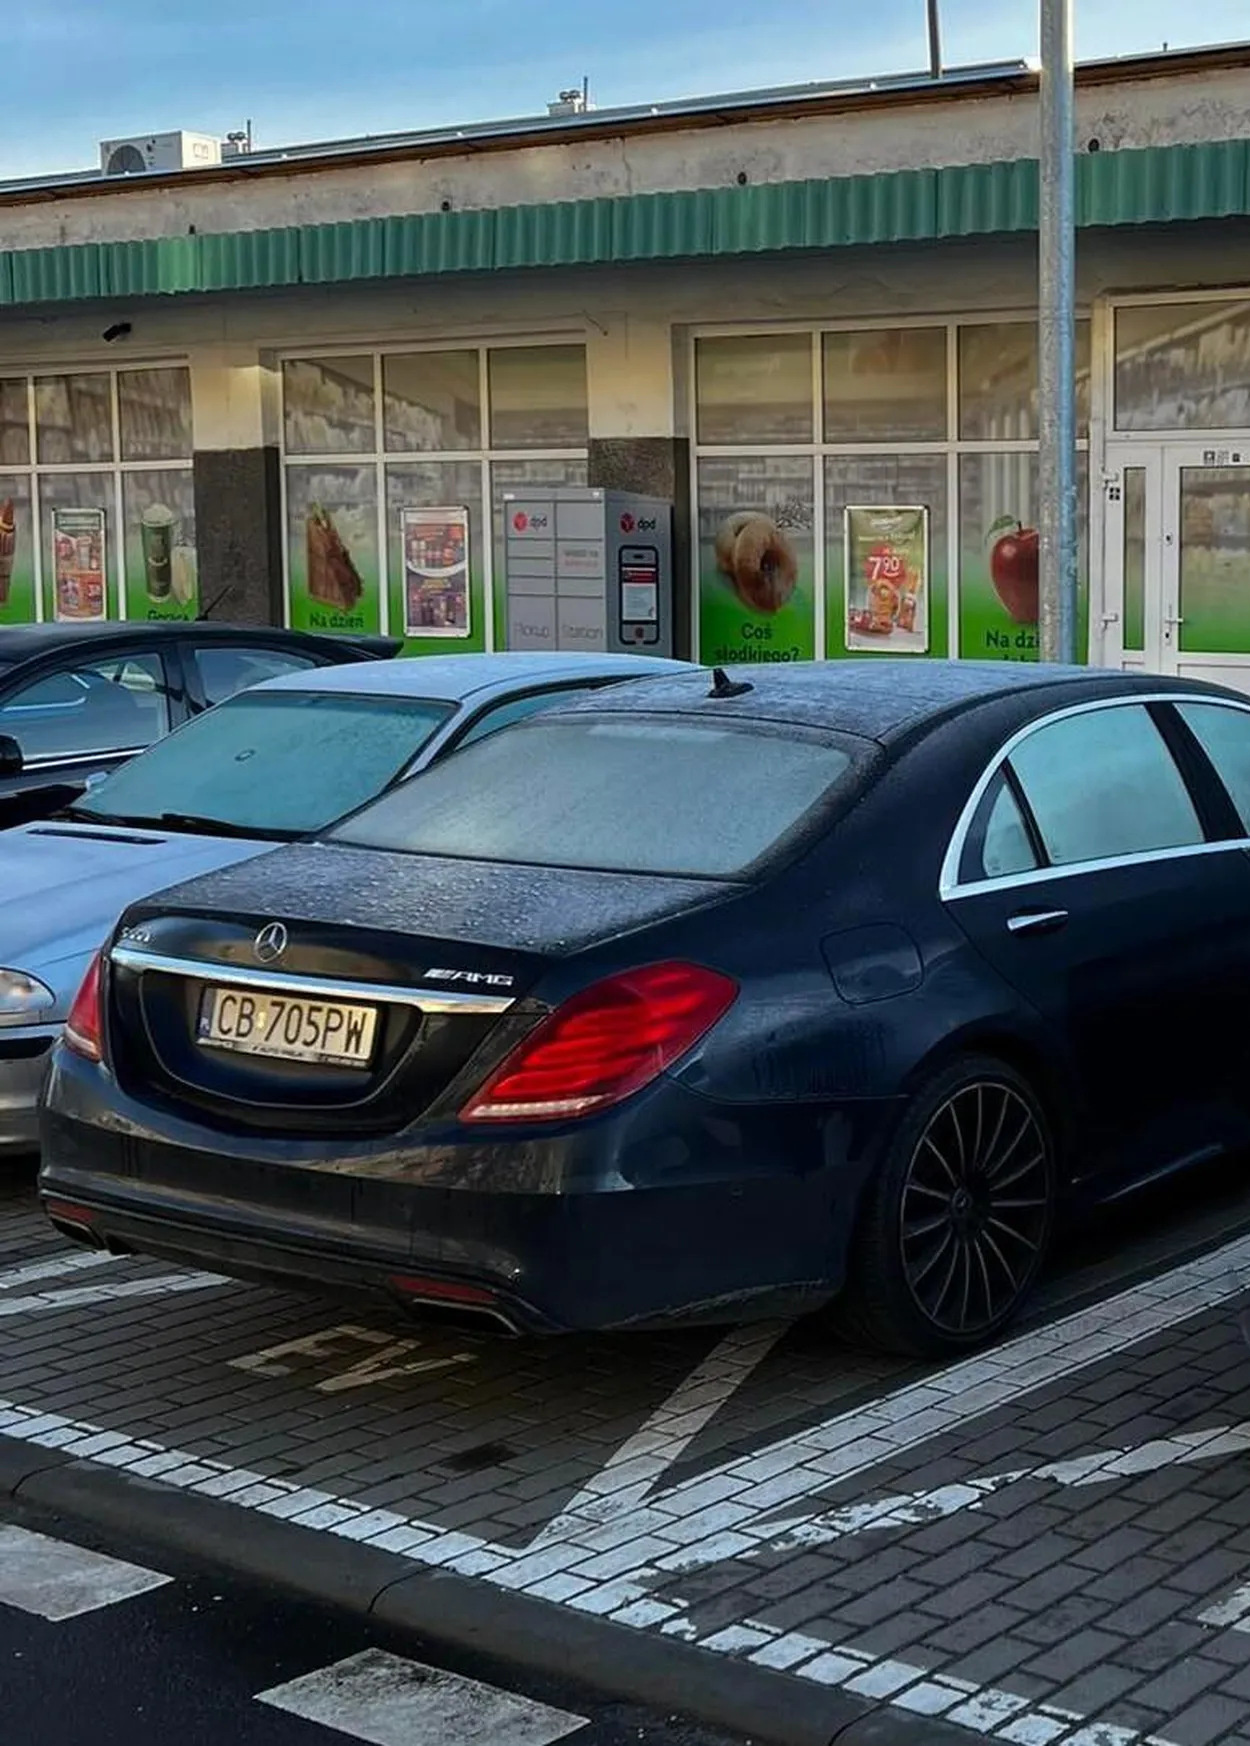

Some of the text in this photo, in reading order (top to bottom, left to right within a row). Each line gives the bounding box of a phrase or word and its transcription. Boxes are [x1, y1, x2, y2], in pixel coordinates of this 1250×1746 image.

[530, 516, 548, 530] dpd
[637, 517, 656, 531] dpd
[741, 622, 773, 639] Coś
[986, 628, 1040, 649] Na dzi
[450, 971, 514, 987] AMG
[218, 995, 367, 1055] CB 705PW
